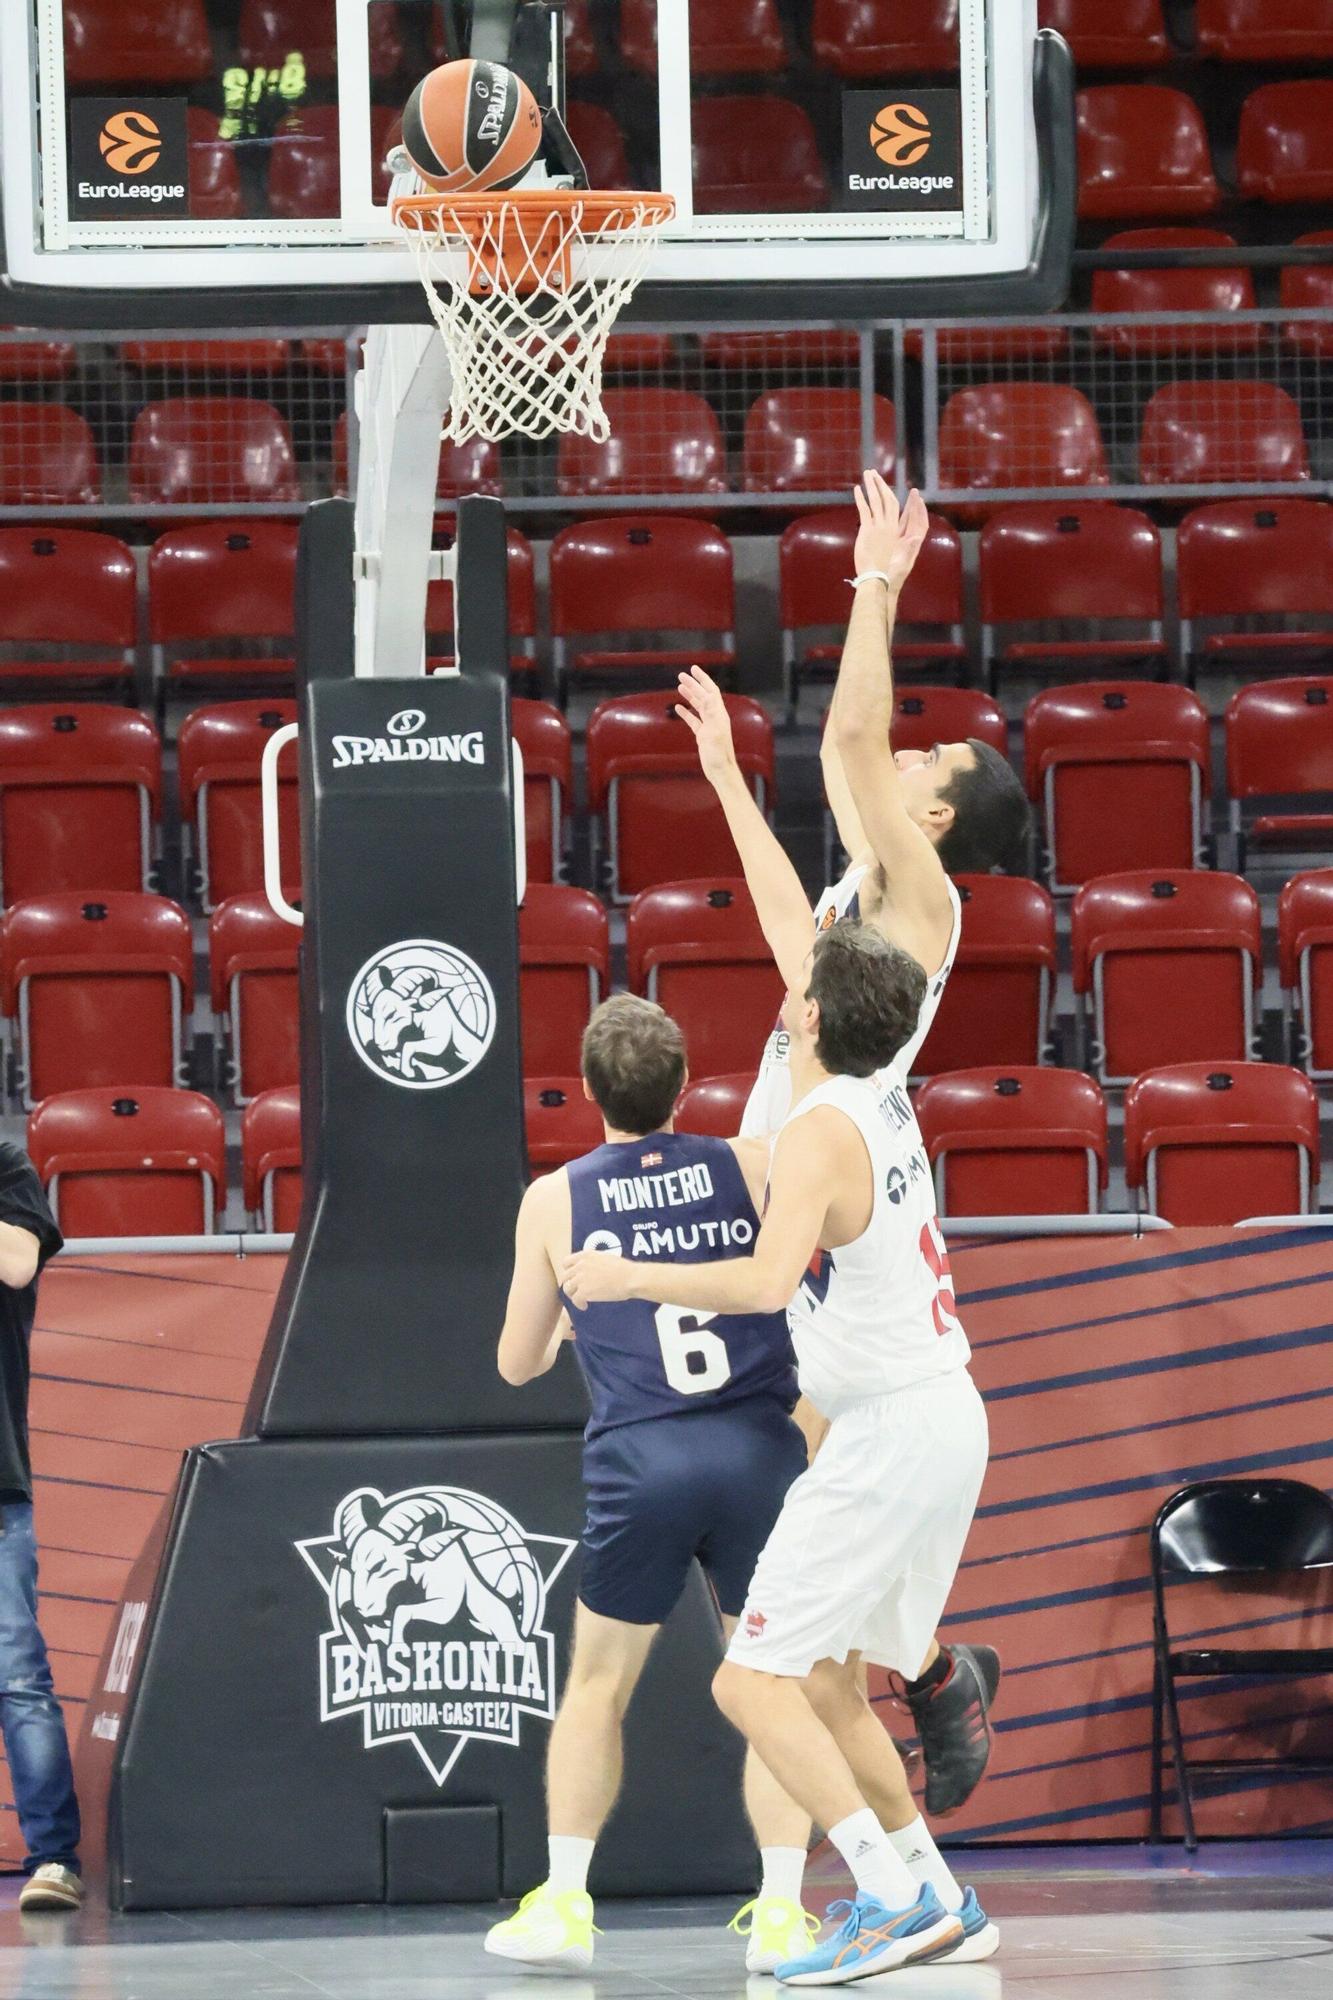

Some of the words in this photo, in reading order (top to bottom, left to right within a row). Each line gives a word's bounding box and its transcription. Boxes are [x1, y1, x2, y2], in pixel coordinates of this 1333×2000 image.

[78, 182, 185, 202] EuroLeague
[848, 173, 954, 194] EuroLeague
[332, 731, 485, 768] SPALDING
[597, 1163, 714, 1213] MONTERO
[631, 1218, 753, 1256] AMUTIO
[632, 1221, 659, 1231] GRUPO
[654, 1302, 732, 1395] 6
[331, 1641, 546, 1704] BASKONIA
